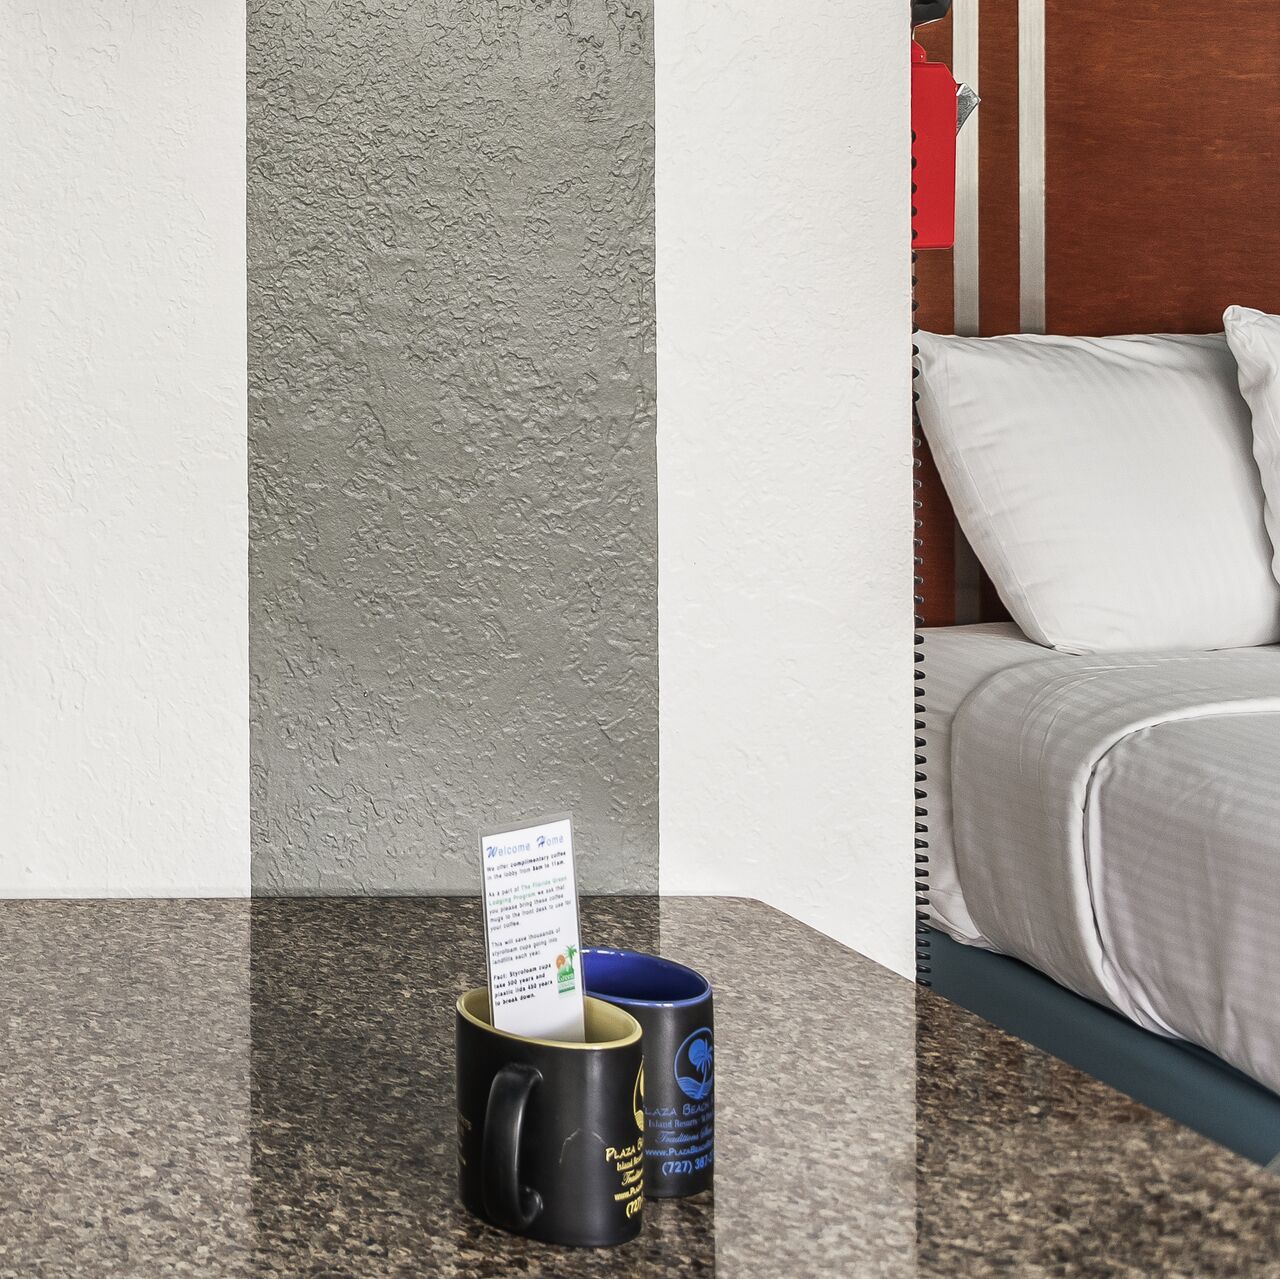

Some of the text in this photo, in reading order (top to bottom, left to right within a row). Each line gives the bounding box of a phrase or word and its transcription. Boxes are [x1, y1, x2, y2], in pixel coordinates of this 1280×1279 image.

[486, 835, 564, 859] Welcome Home
[510, 967, 537, 978] Styrofoam
[662, 1160, 692, 1176] (727)
